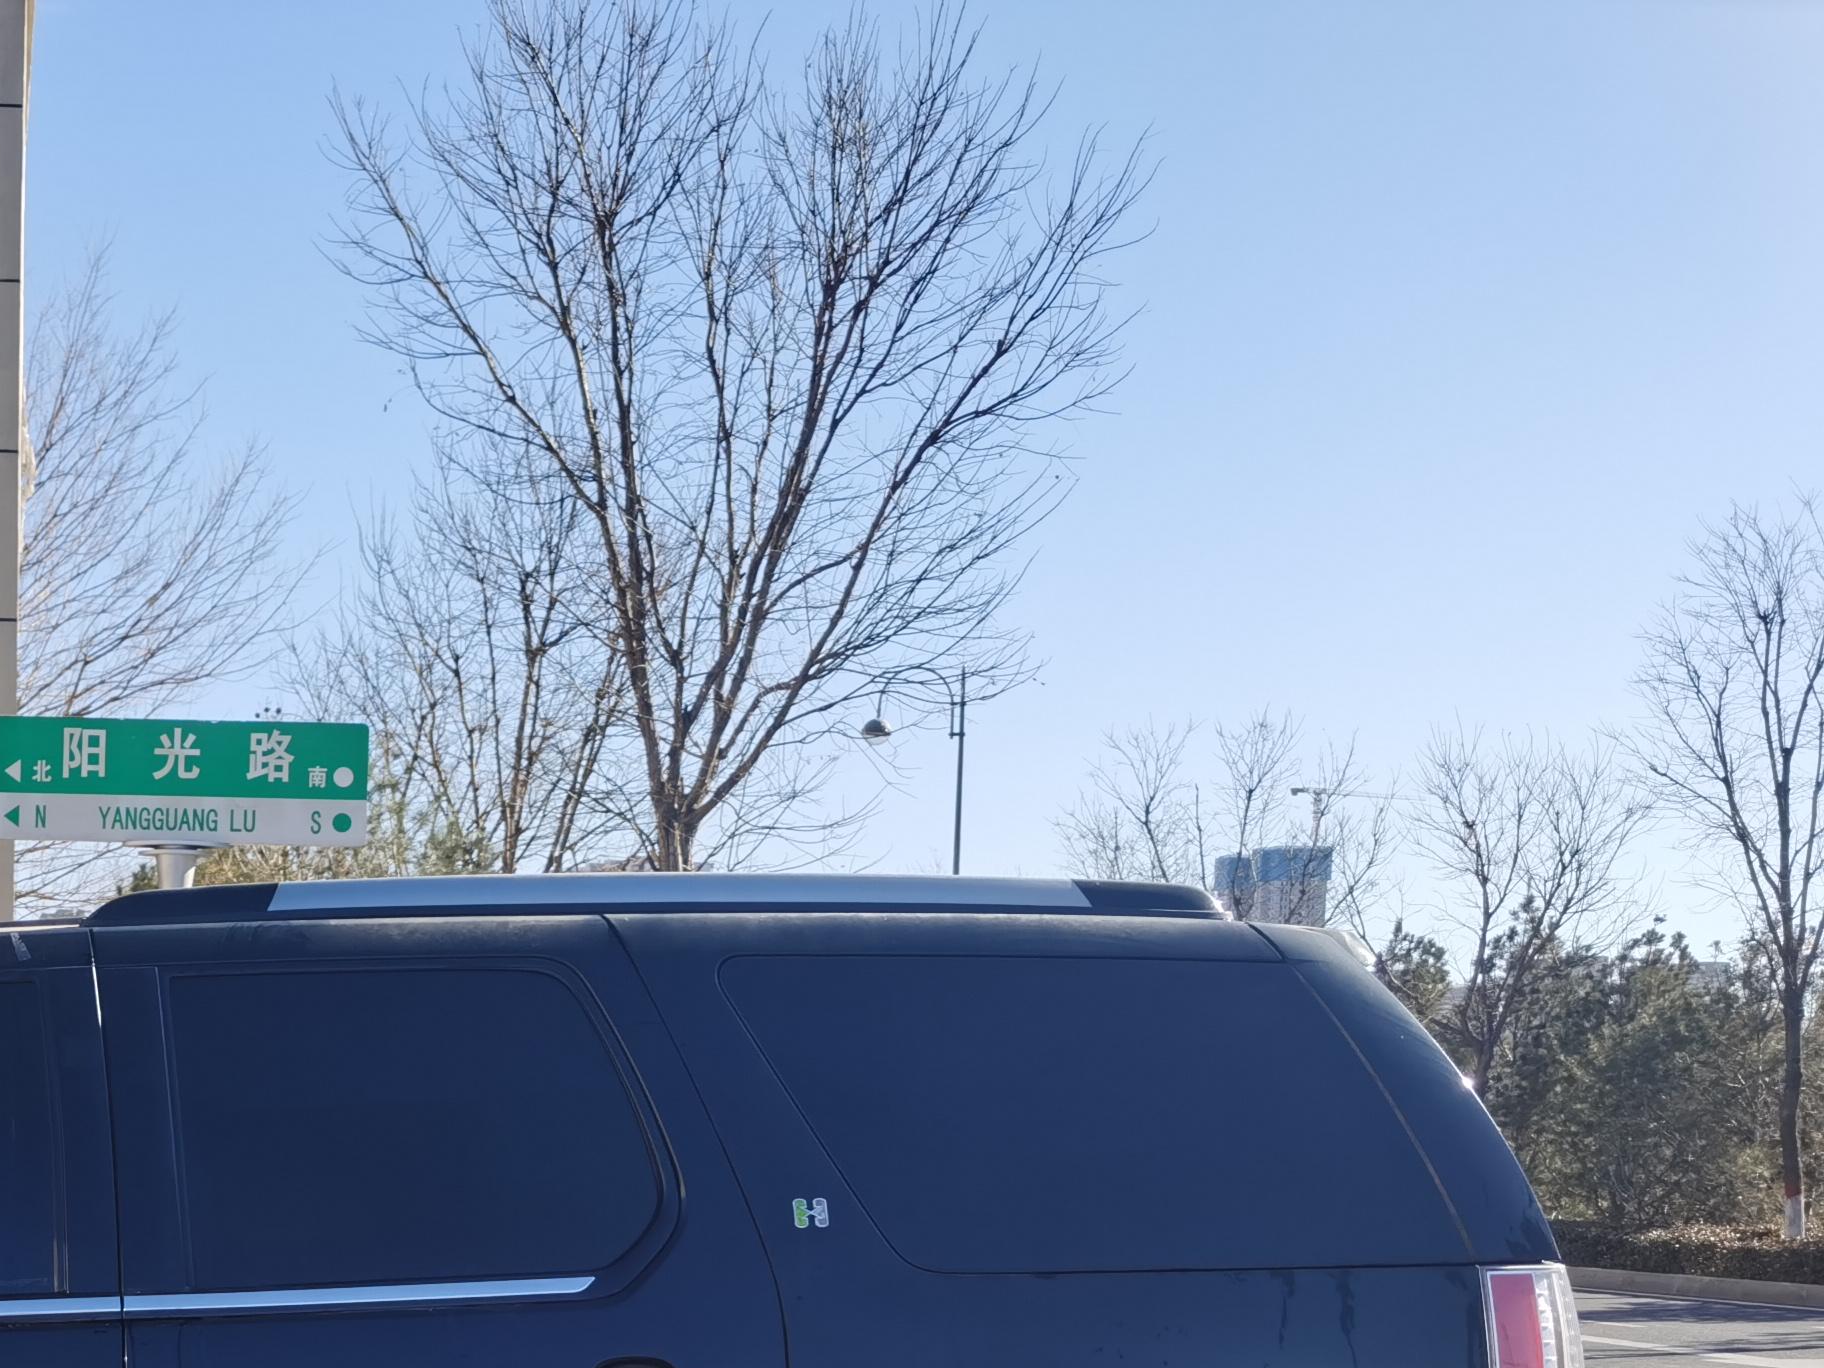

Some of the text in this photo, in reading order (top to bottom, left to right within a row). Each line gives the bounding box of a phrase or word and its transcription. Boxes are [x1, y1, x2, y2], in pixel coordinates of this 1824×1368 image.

[62, 727, 295, 783] 阳光路
[31, 760, 52, 783] 北
[307, 766, 327, 788] 南
[35, 804, 47, 829] N
[99, 806, 257, 833] YANGGUANG LU
[310, 810, 321, 834] S
